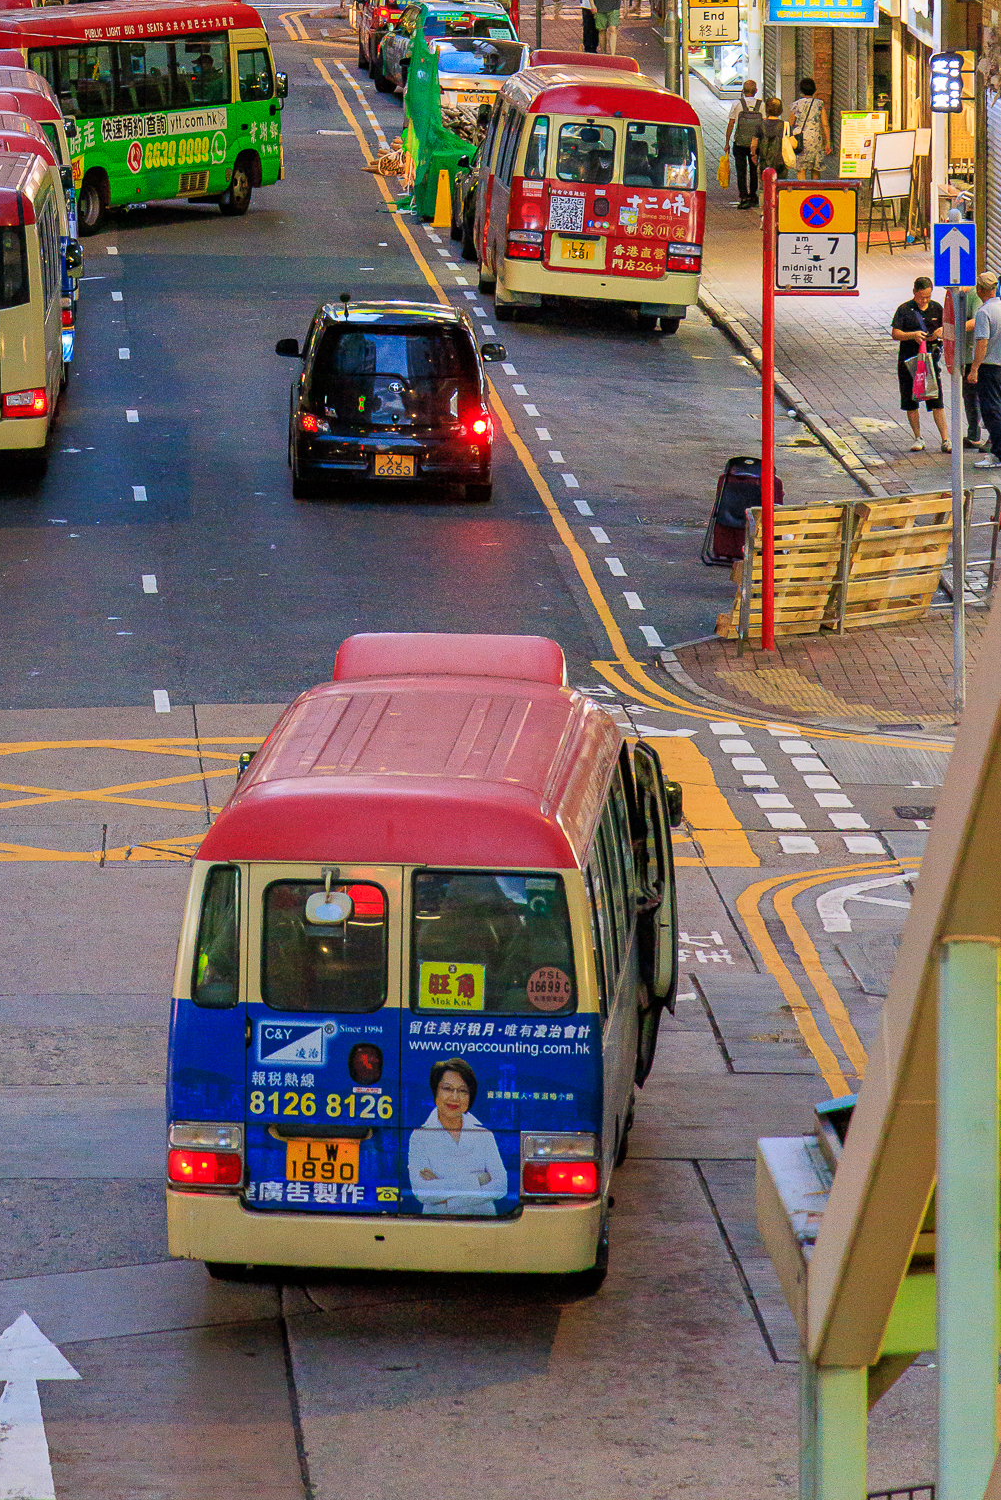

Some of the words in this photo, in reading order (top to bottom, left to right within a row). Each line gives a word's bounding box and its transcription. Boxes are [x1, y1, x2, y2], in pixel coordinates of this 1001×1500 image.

[702, 11, 725, 21] End
[84, 27, 104, 38] PUBLIC
[105, 26, 121, 37] LIGHT
[124, 25, 135, 35] BUS
[137, 24, 144, 33] 19
[146, 22, 164, 32] SEATS
[699, 23, 729, 37] 終止
[144, 140, 176, 169] 6639
[177, 136, 210, 165] 9999
[626, 193, 690, 217] 十二味
[571, 241, 585, 251] LZ
[612, 244, 666, 260] 香港直營
[790, 244, 814, 255] 上午
[826, 237, 840, 255] 7
[611, 258, 664, 273] 門店26+
[782, 263, 823, 273] midnight
[790, 273, 814, 285] 午夜
[828, 266, 851, 285] 12
[386, 455, 403, 466] XJ
[377, 465, 411, 476] 6653
[428, 972, 476, 999] 旺角
[264, 1027, 292, 1040] C&Y
[339, 1024, 362, 1034] Since
[363, 1025, 383, 1034] 1994
[409, 1040, 590, 1057] www.cnyaccounting.com.hk
[251, 1070, 316, 1088] 報稅熱線
[249, 1090, 316, 1116] 8126
[325, 1093, 393, 1120] 8126
[306, 1143, 339, 1162] LW
[291, 1160, 354, 1181] 1890
